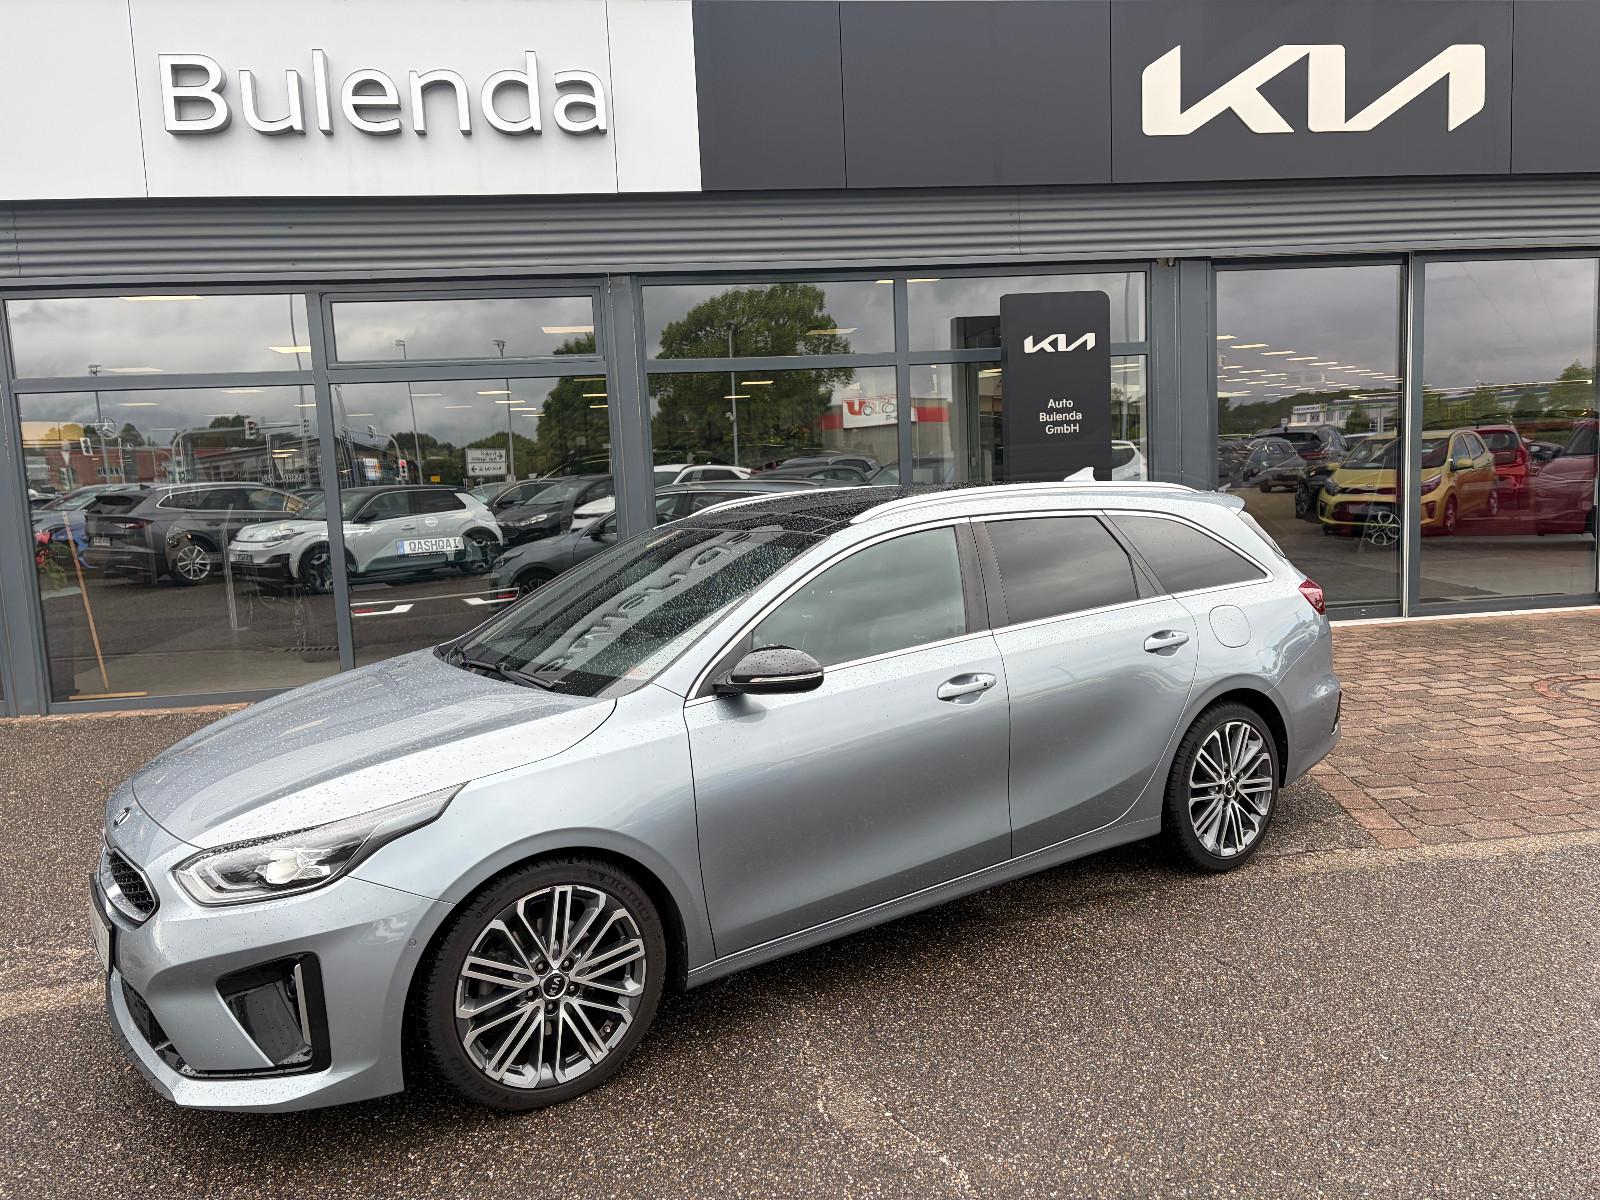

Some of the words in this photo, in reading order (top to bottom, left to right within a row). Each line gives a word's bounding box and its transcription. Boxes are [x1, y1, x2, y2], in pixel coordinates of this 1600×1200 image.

[158, 49, 608, 135] Bulenda
[1142, 44, 1485, 136] KIA
[1023, 332, 1096, 354] KIA
[1047, 398, 1074, 409] Auto
[1039, 411, 1083, 422] Bulenda
[1045, 423, 1080, 435] GmbH
[408, 538, 459, 552] QASHQAI
